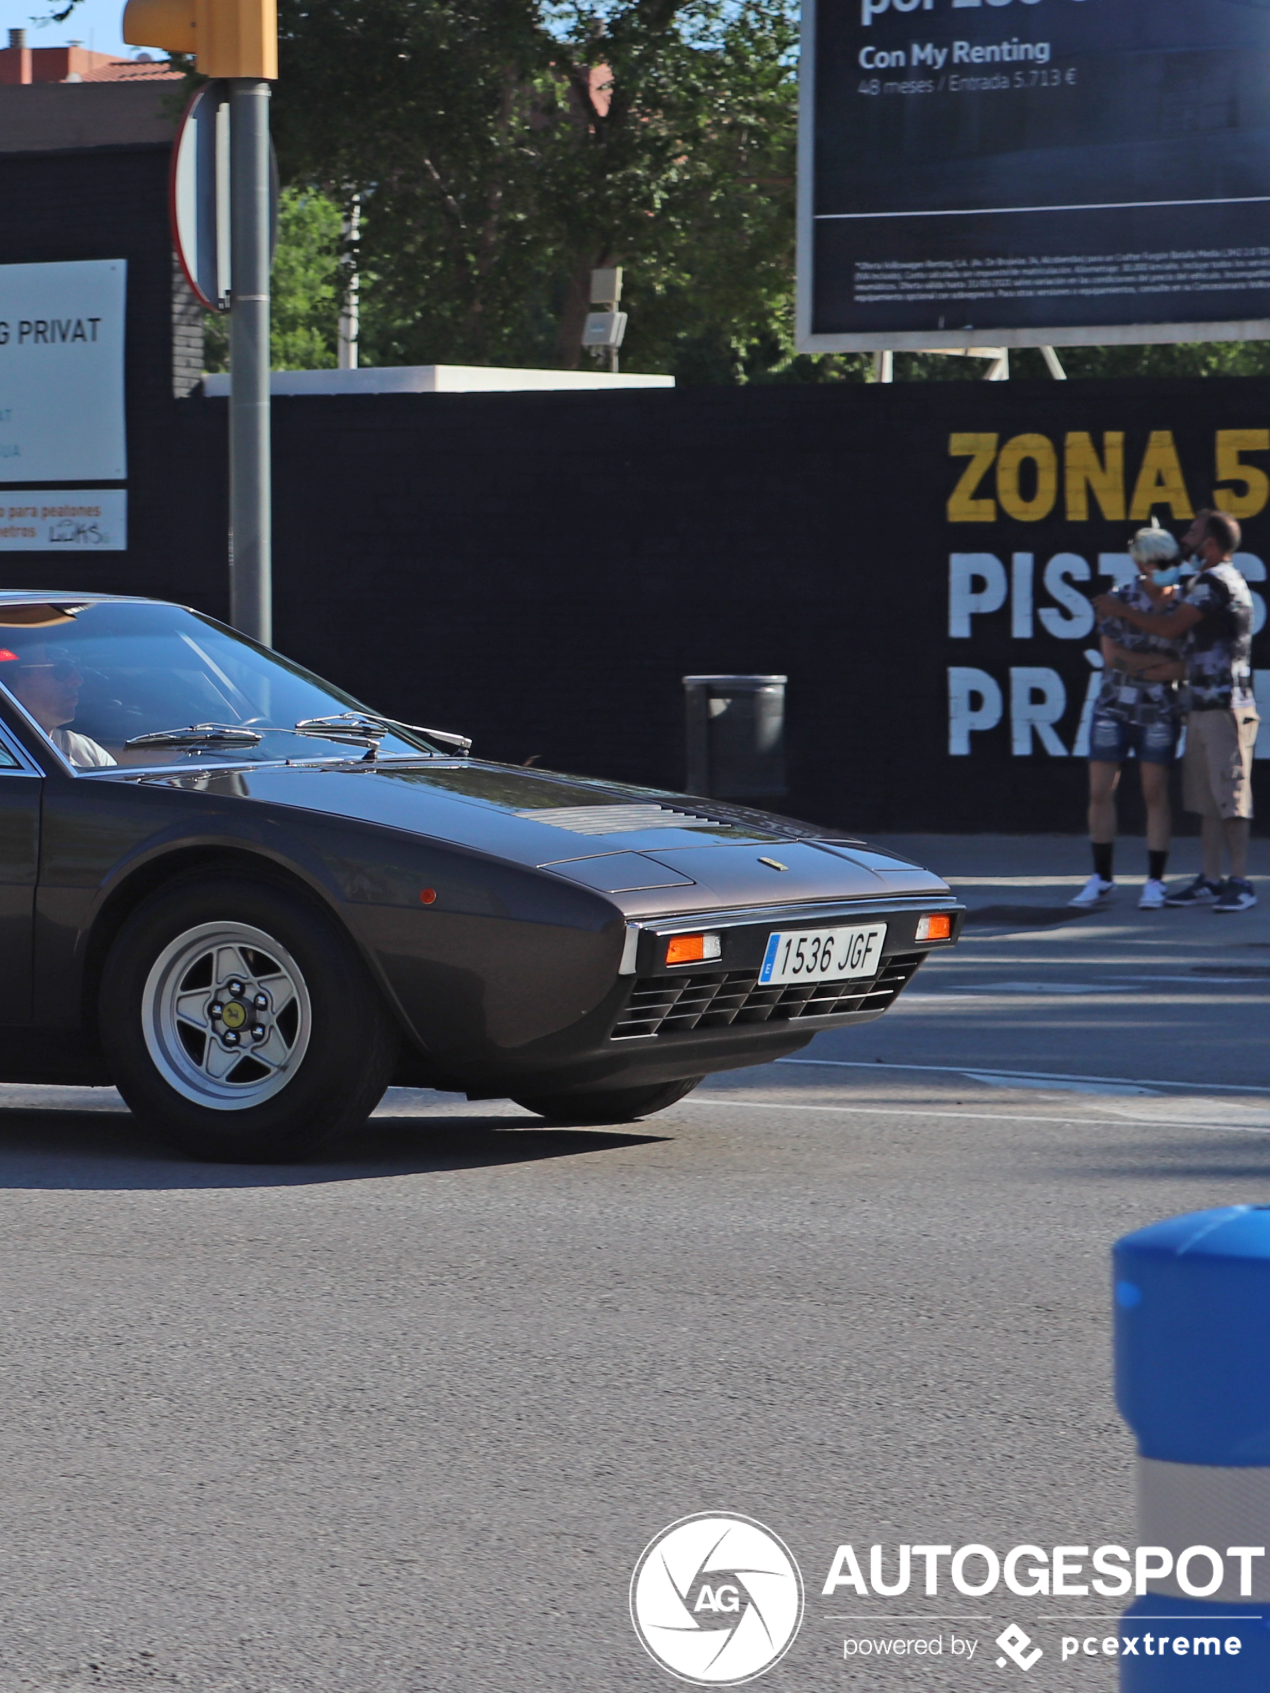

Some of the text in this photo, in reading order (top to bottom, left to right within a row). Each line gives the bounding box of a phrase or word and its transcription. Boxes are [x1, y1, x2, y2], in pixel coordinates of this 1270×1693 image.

[858, 37, 1050, 70] Con My Renting
[857, 79, 881, 95] 48
[883, 78, 934, 94] meses
[949, 72, 1010, 92] Entrada
[1013, 68, 1062, 88] 5.713
[1064, 67, 1078, 85] €
[18, 317, 102, 345] PRIVAT
[947, 429, 1270, 522] ZONA 5
[9, 505, 39, 521] para
[42, 504, 102, 521] peatones
[782, 932, 878, 975] 1536 JGF
